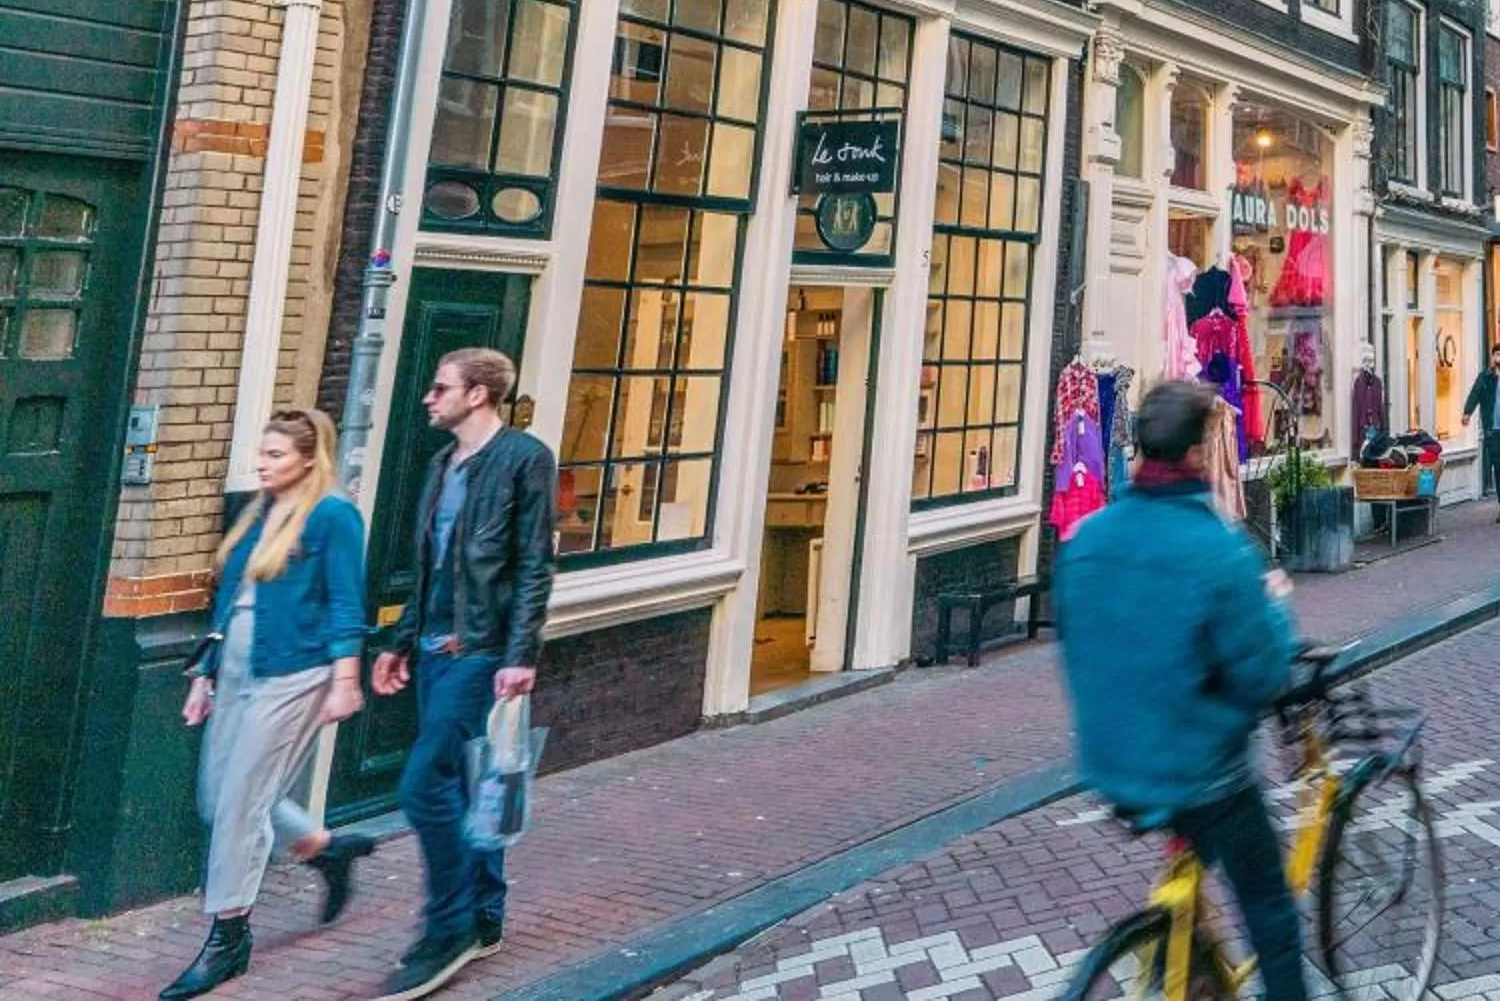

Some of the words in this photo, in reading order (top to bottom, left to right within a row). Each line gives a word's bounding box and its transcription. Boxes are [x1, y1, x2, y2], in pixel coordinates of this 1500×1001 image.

[815, 172, 832, 183] hair
[833, 172, 841, 183] &
[842, 172, 879, 183] make-up
[1232, 192, 1277, 227] AURA
[1286, 203, 1329, 234] DOLS
